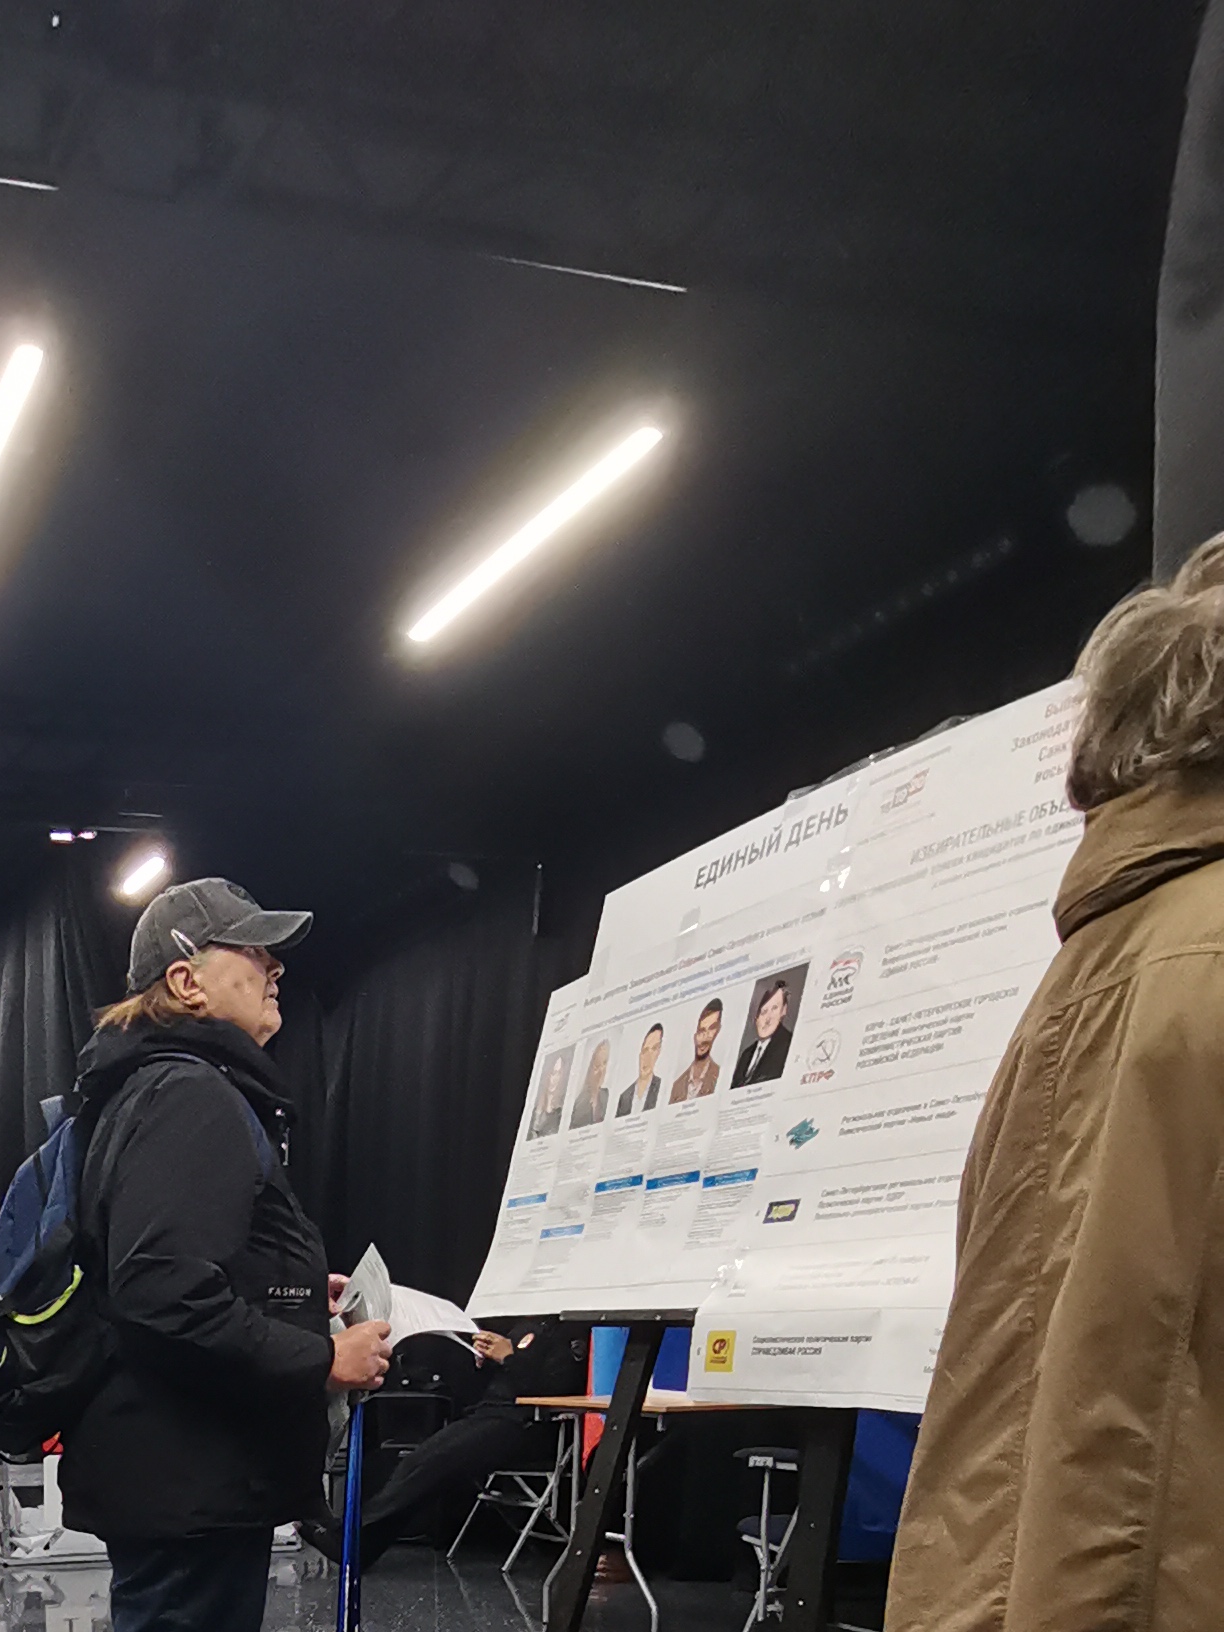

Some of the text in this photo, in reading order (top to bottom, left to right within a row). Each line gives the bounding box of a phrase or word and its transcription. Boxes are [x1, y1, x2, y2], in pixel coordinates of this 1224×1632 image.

[1029, 799, 1073, 824] ОБЪЕ
[694, 822, 784, 890] ЕДИНЫЙ
[784, 803, 849, 853] ДЕНЬ
[799, 1069, 836, 1086] КПРФ
[268, 1286, 312, 1297] FASHION
